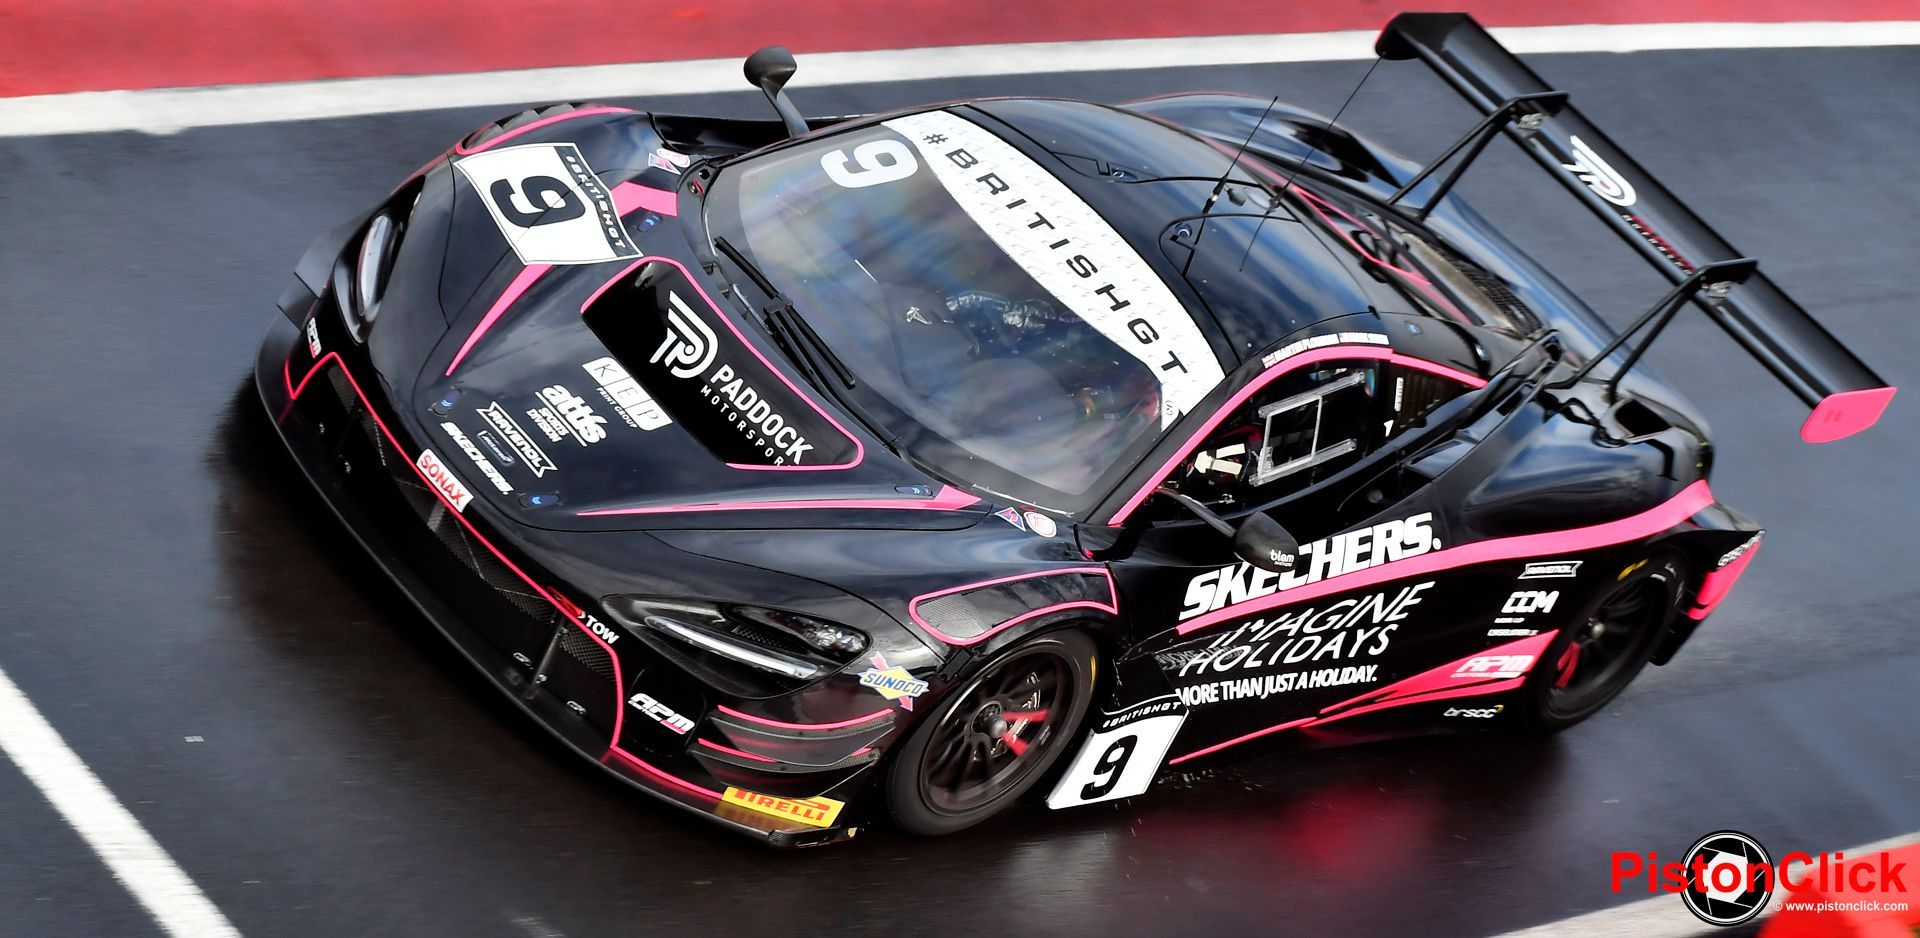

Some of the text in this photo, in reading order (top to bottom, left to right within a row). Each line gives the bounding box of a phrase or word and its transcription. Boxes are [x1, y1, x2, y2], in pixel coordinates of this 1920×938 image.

[820, 139, 919, 188] 9
[490, 175, 586, 228] 9
[923, 132, 1188, 375] #BRITISHGT
[526, 408, 563, 443] DIVISION
[538, 407, 570, 437] SPORTS
[595, 387, 638, 428] PRINT GROUP
[700, 384, 792, 467] MOTORSPOR
[710, 364, 814, 465] PADDOCK
[487, 409, 544, 470] RAVENOL
[420, 454, 466, 506] SONAX
[585, 614, 620, 645] TOW
[1179, 624, 1399, 677] HOLIDAYS
[863, 673, 925, 695] SUNOCO
[1175, 665, 1379, 707] MORE THAN JUST A HOLIDAY.
[1080, 734, 1138, 800] 9
